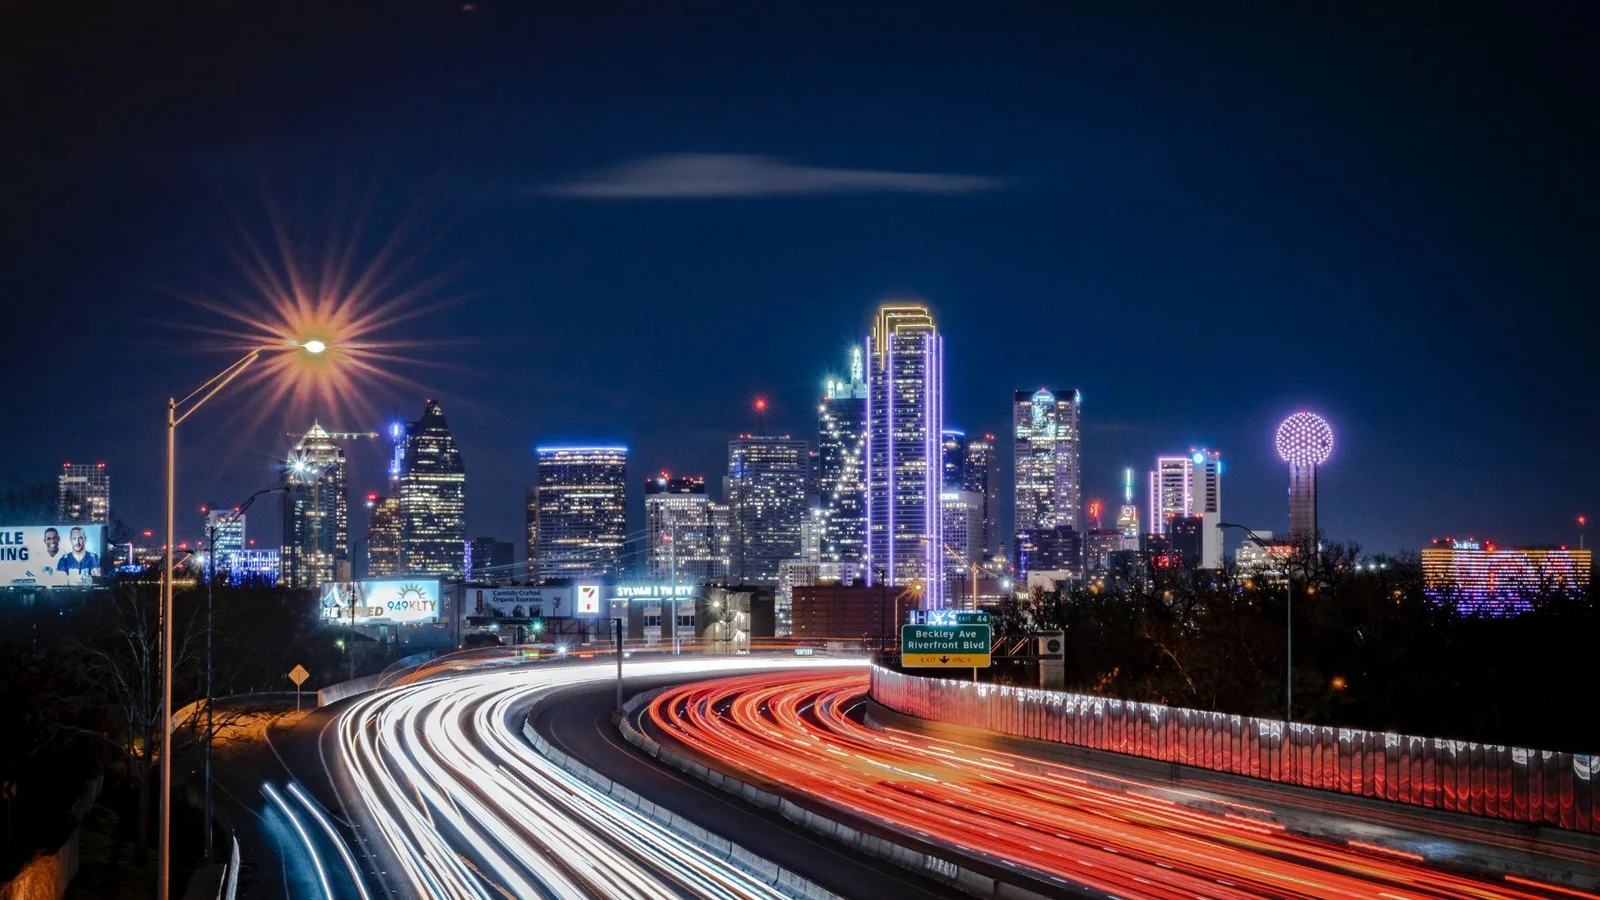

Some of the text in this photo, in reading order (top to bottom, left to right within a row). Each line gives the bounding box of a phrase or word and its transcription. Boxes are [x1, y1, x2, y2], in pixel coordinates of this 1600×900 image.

[617, 586, 652, 596] SYLVAN
[660, 586, 693, 596] THRTY
[916, 630, 977, 640] Beckley Ave
[908, 641, 985, 649] Riverfront Blvd
